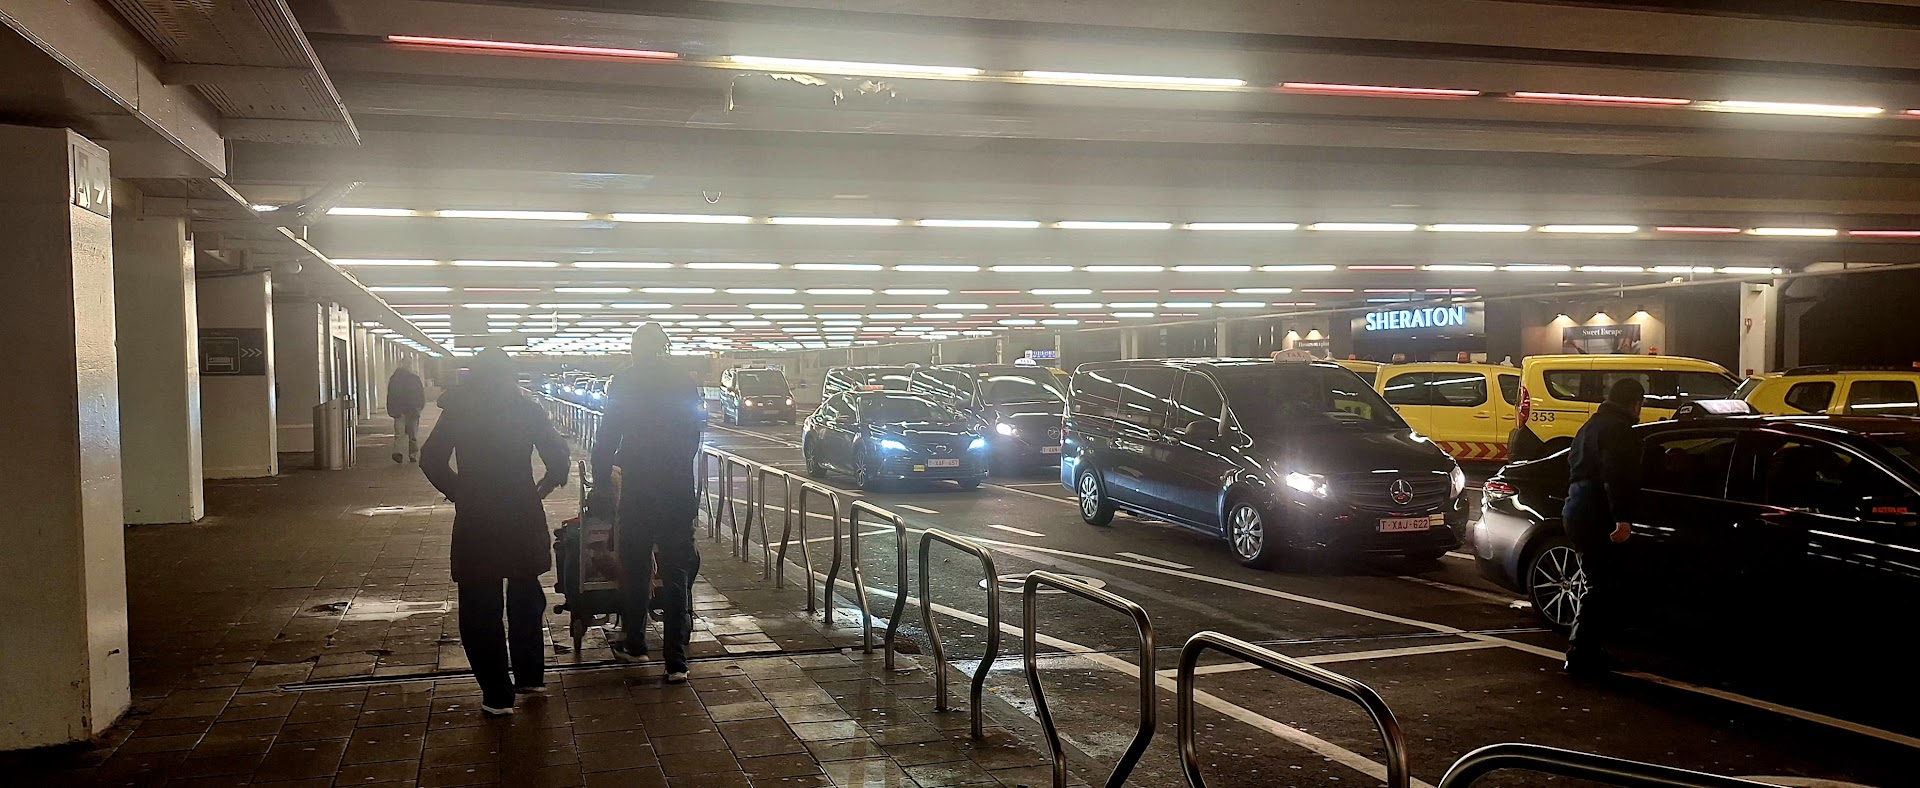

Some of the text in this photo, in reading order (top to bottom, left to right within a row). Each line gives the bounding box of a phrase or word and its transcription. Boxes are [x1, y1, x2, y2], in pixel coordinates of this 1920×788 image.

[1365, 306, 1465, 331] SHERATON
[1601, 328, 1622, 337] Escape
[1531, 411, 1555, 422] 353
[1381, 519, 1429, 530] T-XAJ-622
